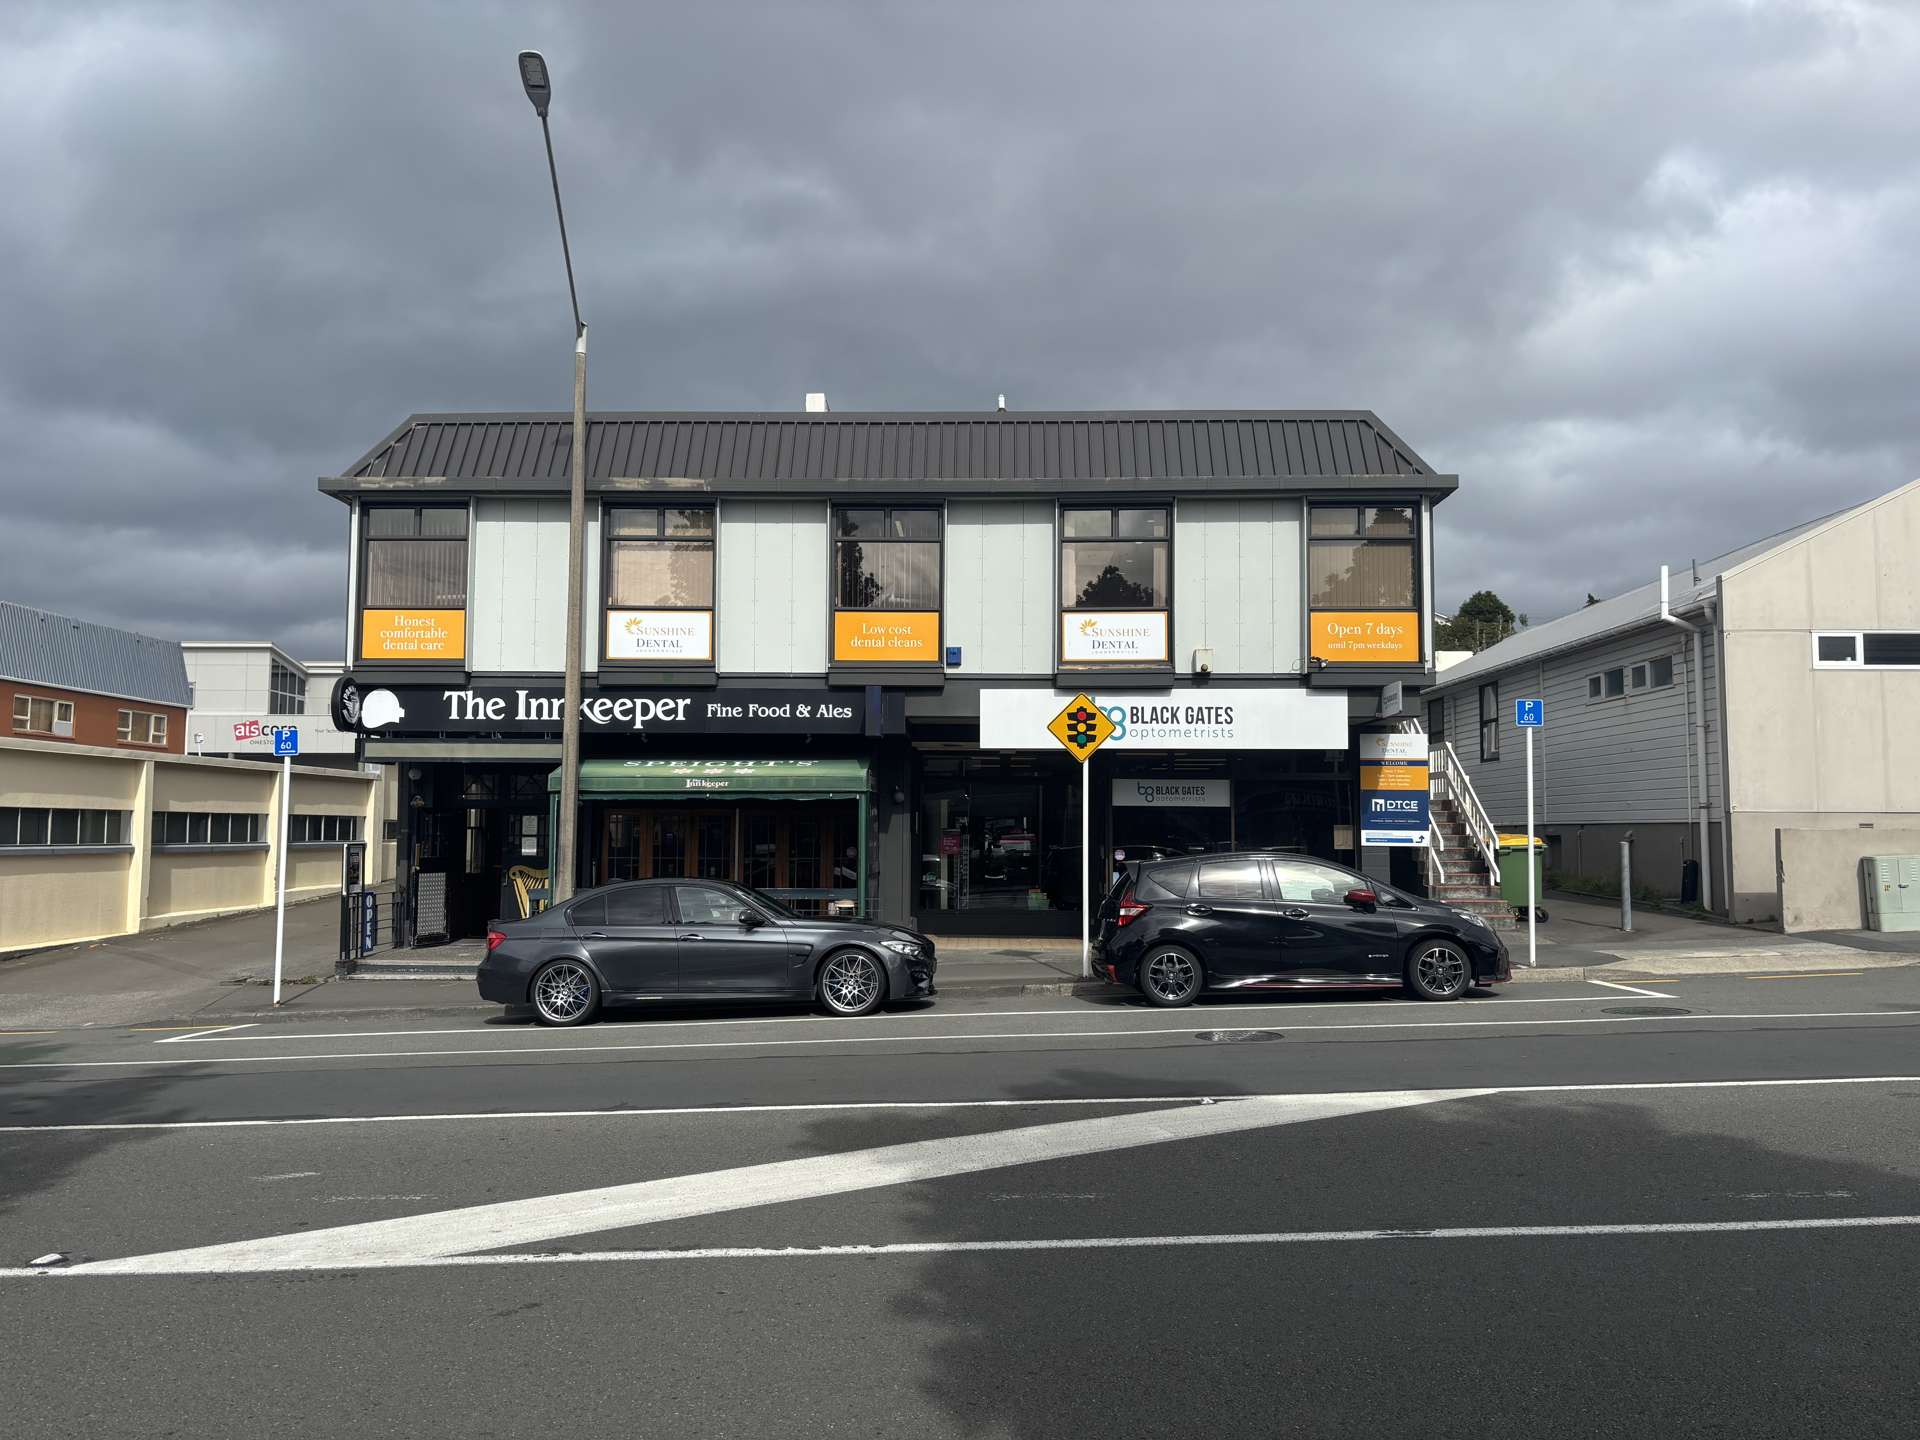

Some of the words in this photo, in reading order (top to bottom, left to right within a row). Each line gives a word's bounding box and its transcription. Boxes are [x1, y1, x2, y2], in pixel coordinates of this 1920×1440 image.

[394, 615, 435, 627] Honest
[380, 627, 448, 639] comfortable
[637, 625, 695, 637] SUNSHINE
[862, 623, 886, 635] Low
[888, 624, 913, 635] cost
[1092, 627, 1151, 638] SUNSHINE
[1327, 622, 1361, 638] Open
[1364, 622, 1374, 635] 7
[1376, 622, 1404, 639] days
[383, 639, 418, 650] dental
[420, 642, 445, 650] care
[636, 638, 683, 648] DENTAL
[851, 636, 885, 648] dental
[888, 636, 923, 648] cleans
[1092, 639, 1138, 650] DENTAL
[1328, 640, 1346, 649] until
[1347, 641, 1365, 652] 7pm
[1366, 641, 1402, 652] weekdays
[443, 690, 506, 720] The
[1525, 701, 1534, 711] P
[707, 703, 743, 718] Fine
[748, 703, 791, 718] Food
[796, 704, 811, 718] &
[816, 704, 853, 719] Ales
[1130, 706, 1180, 725] BLACK
[1185, 706, 1234, 725] GATES
[1523, 713, 1535, 721] 60
[282, 730, 291, 741] P
[1130, 727, 1234, 740] optometrists
[280, 741, 292, 750] 60
[623, 759, 819, 767] SPEIGHT'S
[685, 778, 729, 789] Innkeeper
[1155, 785, 1180, 796] BLACK
[1181, 785, 1206, 796] GATES
[1386, 800, 1419, 809] DTCE
[365, 894, 374, 949] OPEN
